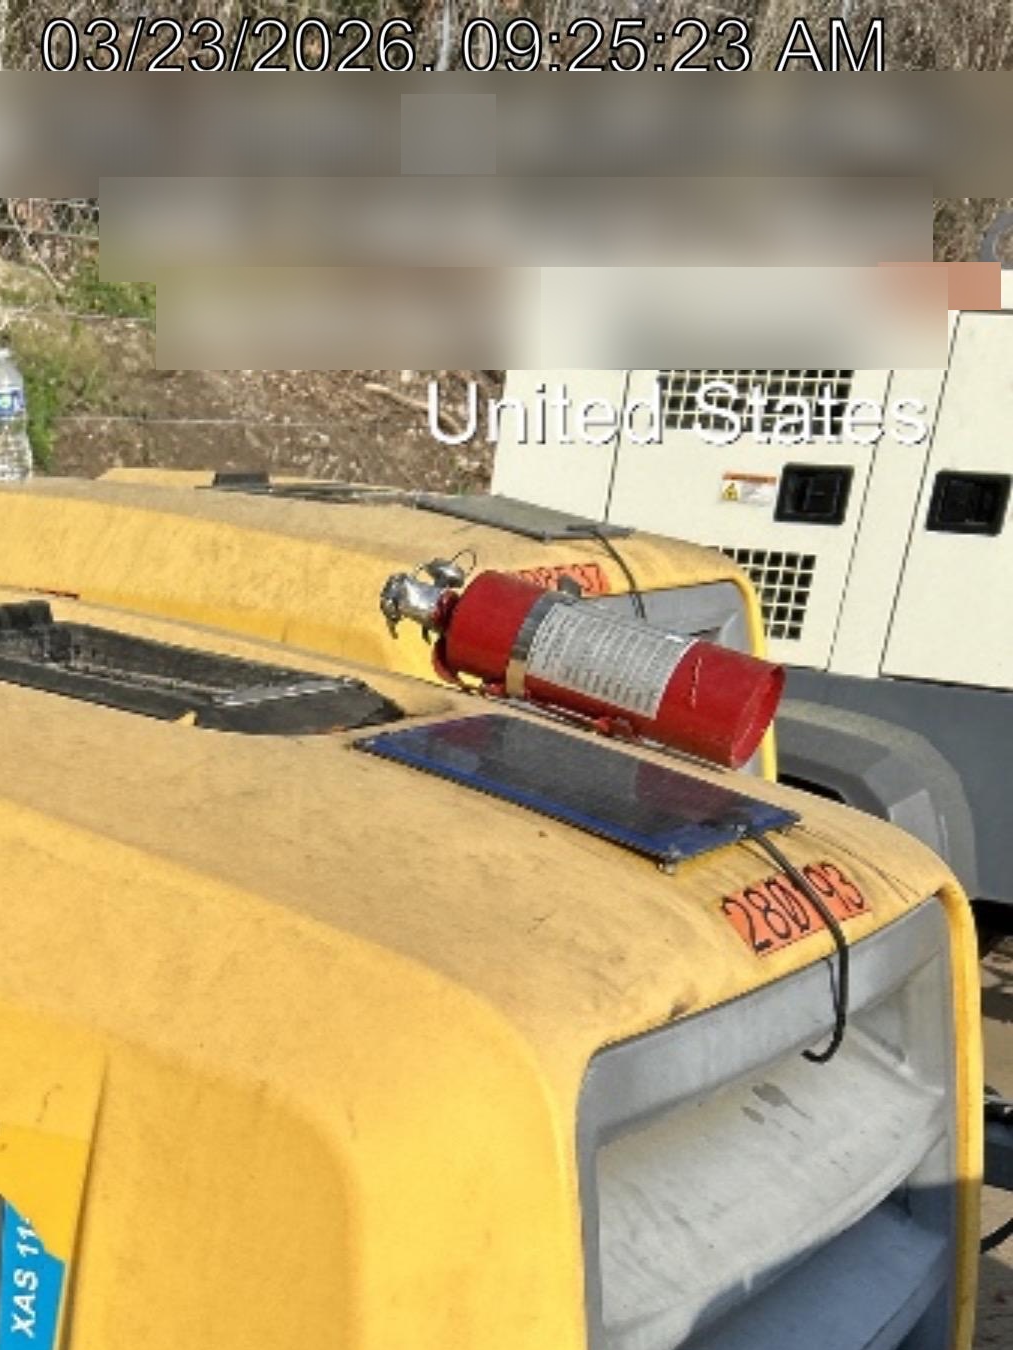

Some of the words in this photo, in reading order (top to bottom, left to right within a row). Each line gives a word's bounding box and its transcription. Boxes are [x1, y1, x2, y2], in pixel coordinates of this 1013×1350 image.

[722, 862, 864, 952] 28093
[15, 1217, 40, 1258] 11
[10, 1268, 39, 1339] XAS
